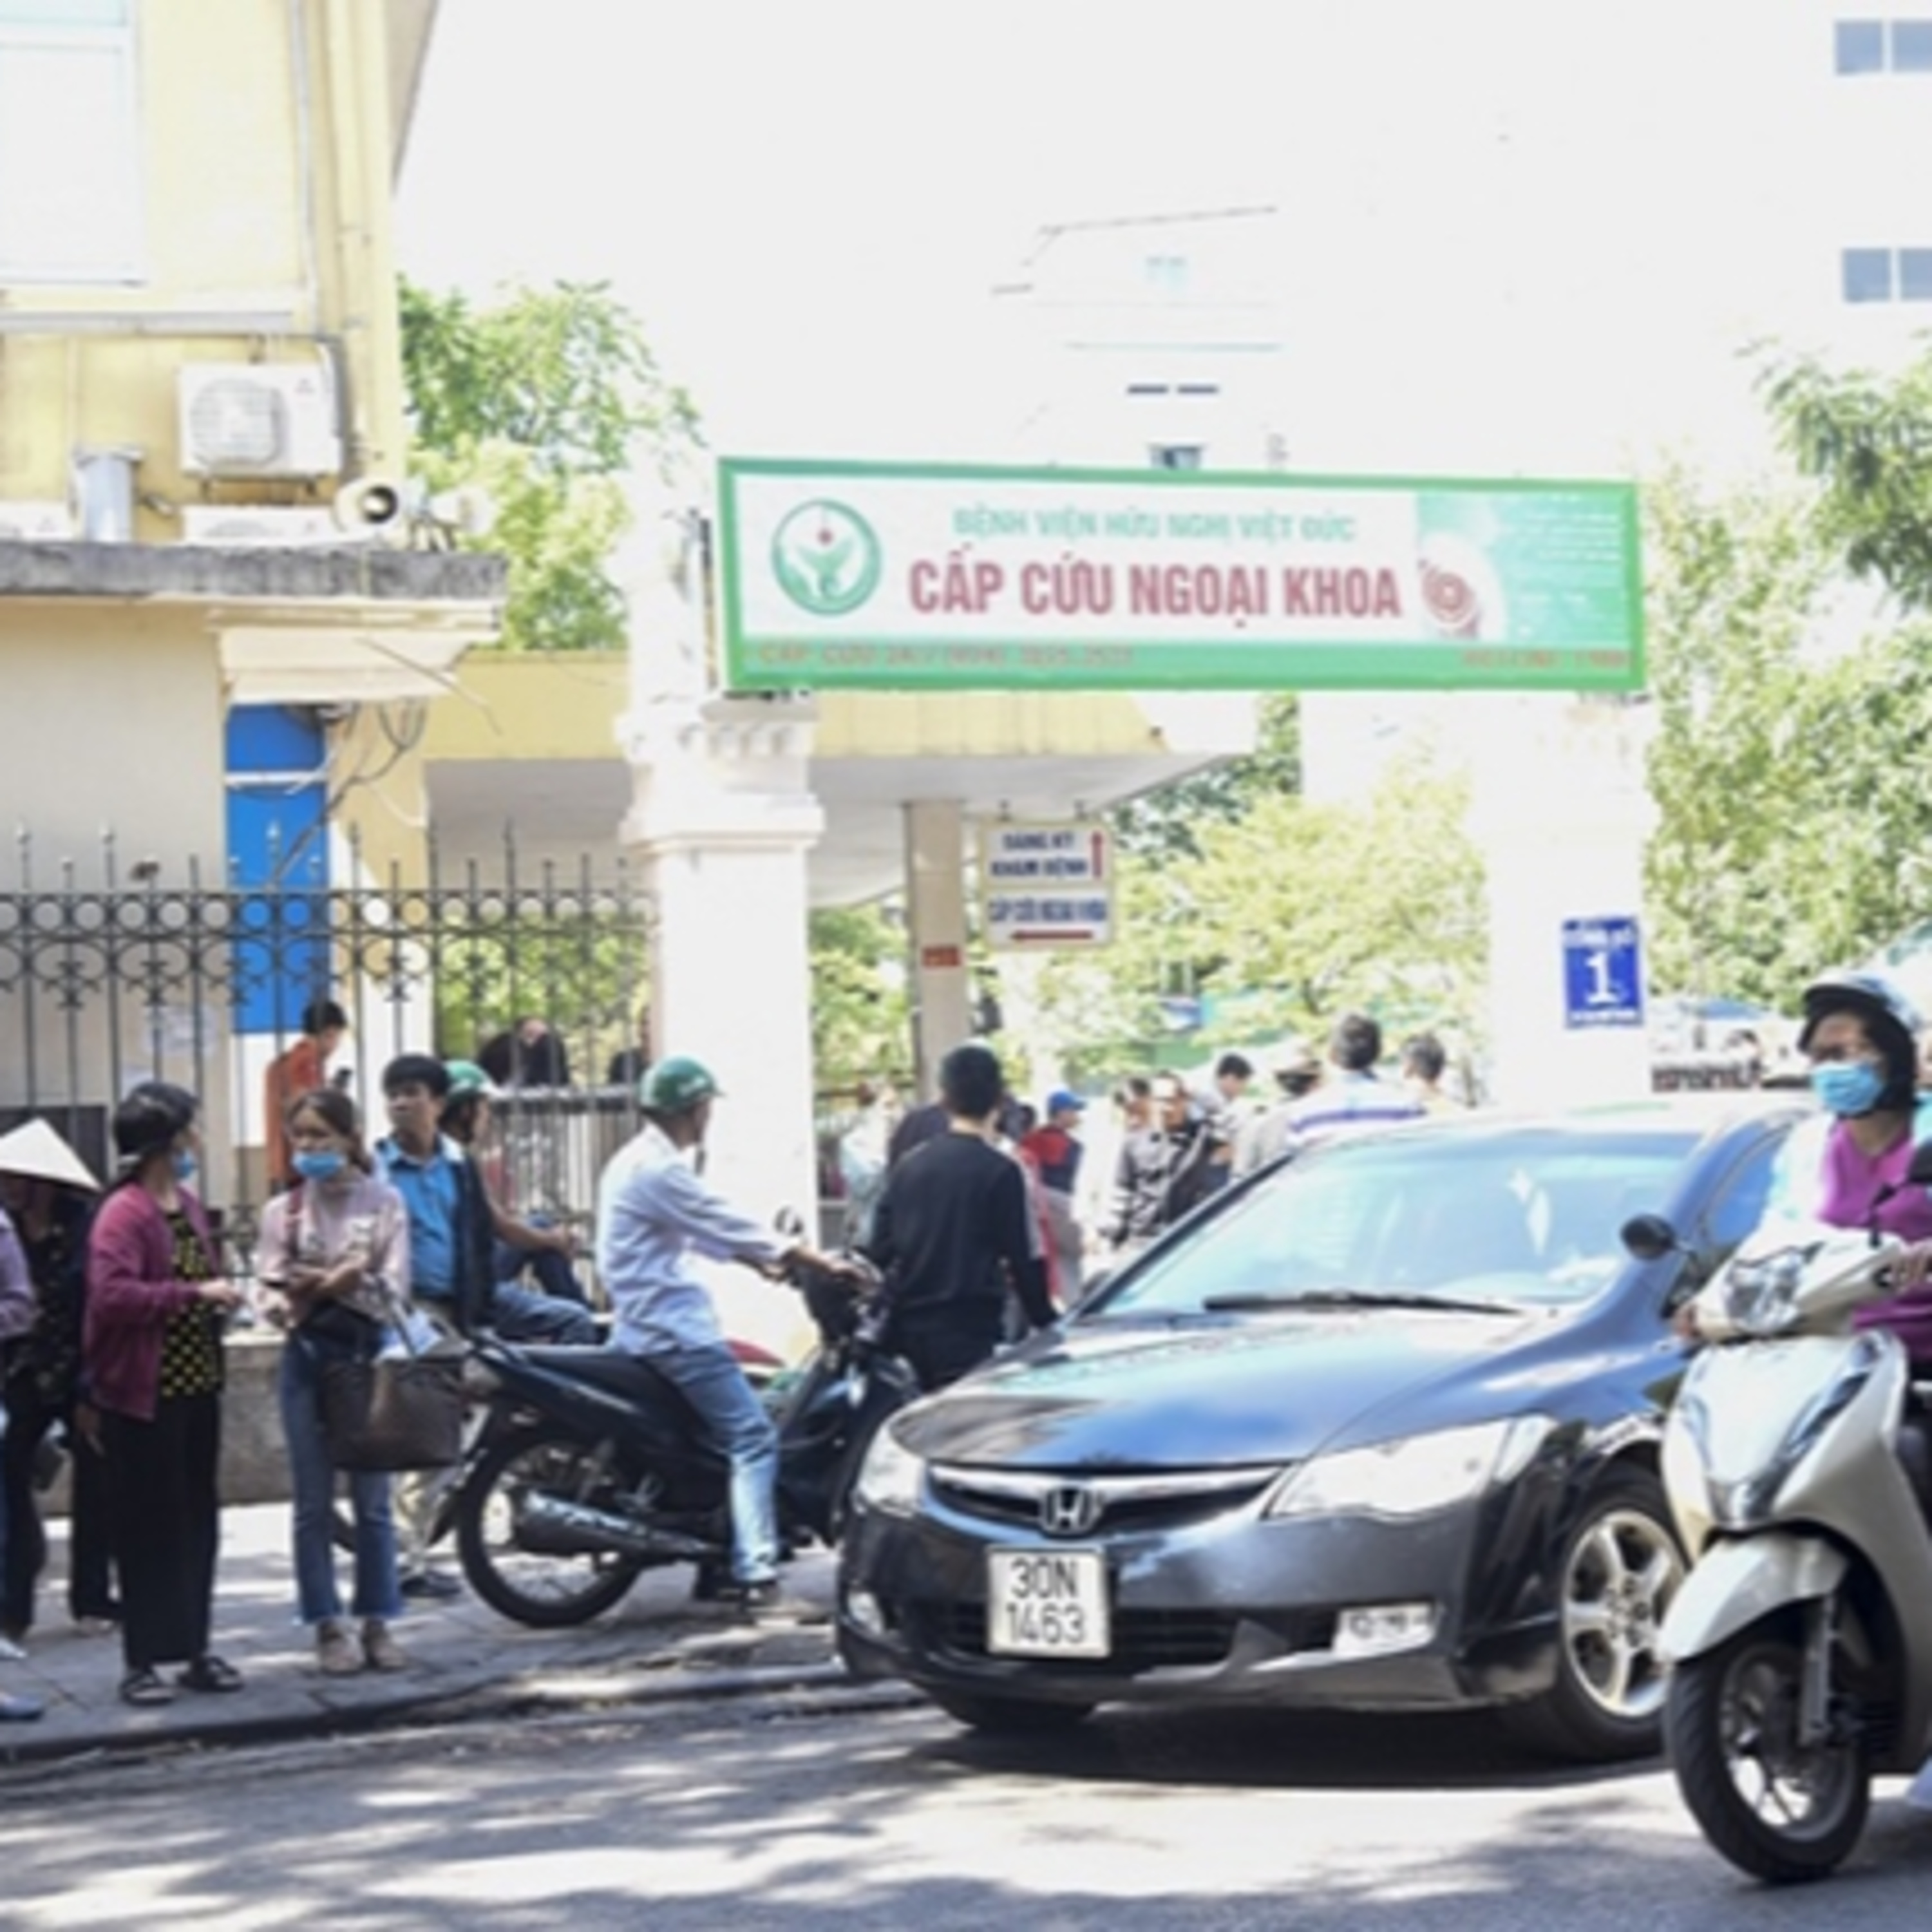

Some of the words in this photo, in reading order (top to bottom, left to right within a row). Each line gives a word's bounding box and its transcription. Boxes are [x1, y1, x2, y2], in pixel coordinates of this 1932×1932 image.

[909, 541, 1004, 614] CẤP
[1019, 551, 1113, 615] CỨU
[1128, 563, 1269, 629] NGOẠI
[1283, 566, 1403, 618] KHOA
[1586, 951, 1620, 1004] 1
[1010, 1557, 1079, 1600] 30N
[1006, 1602, 1086, 1645] 1463
